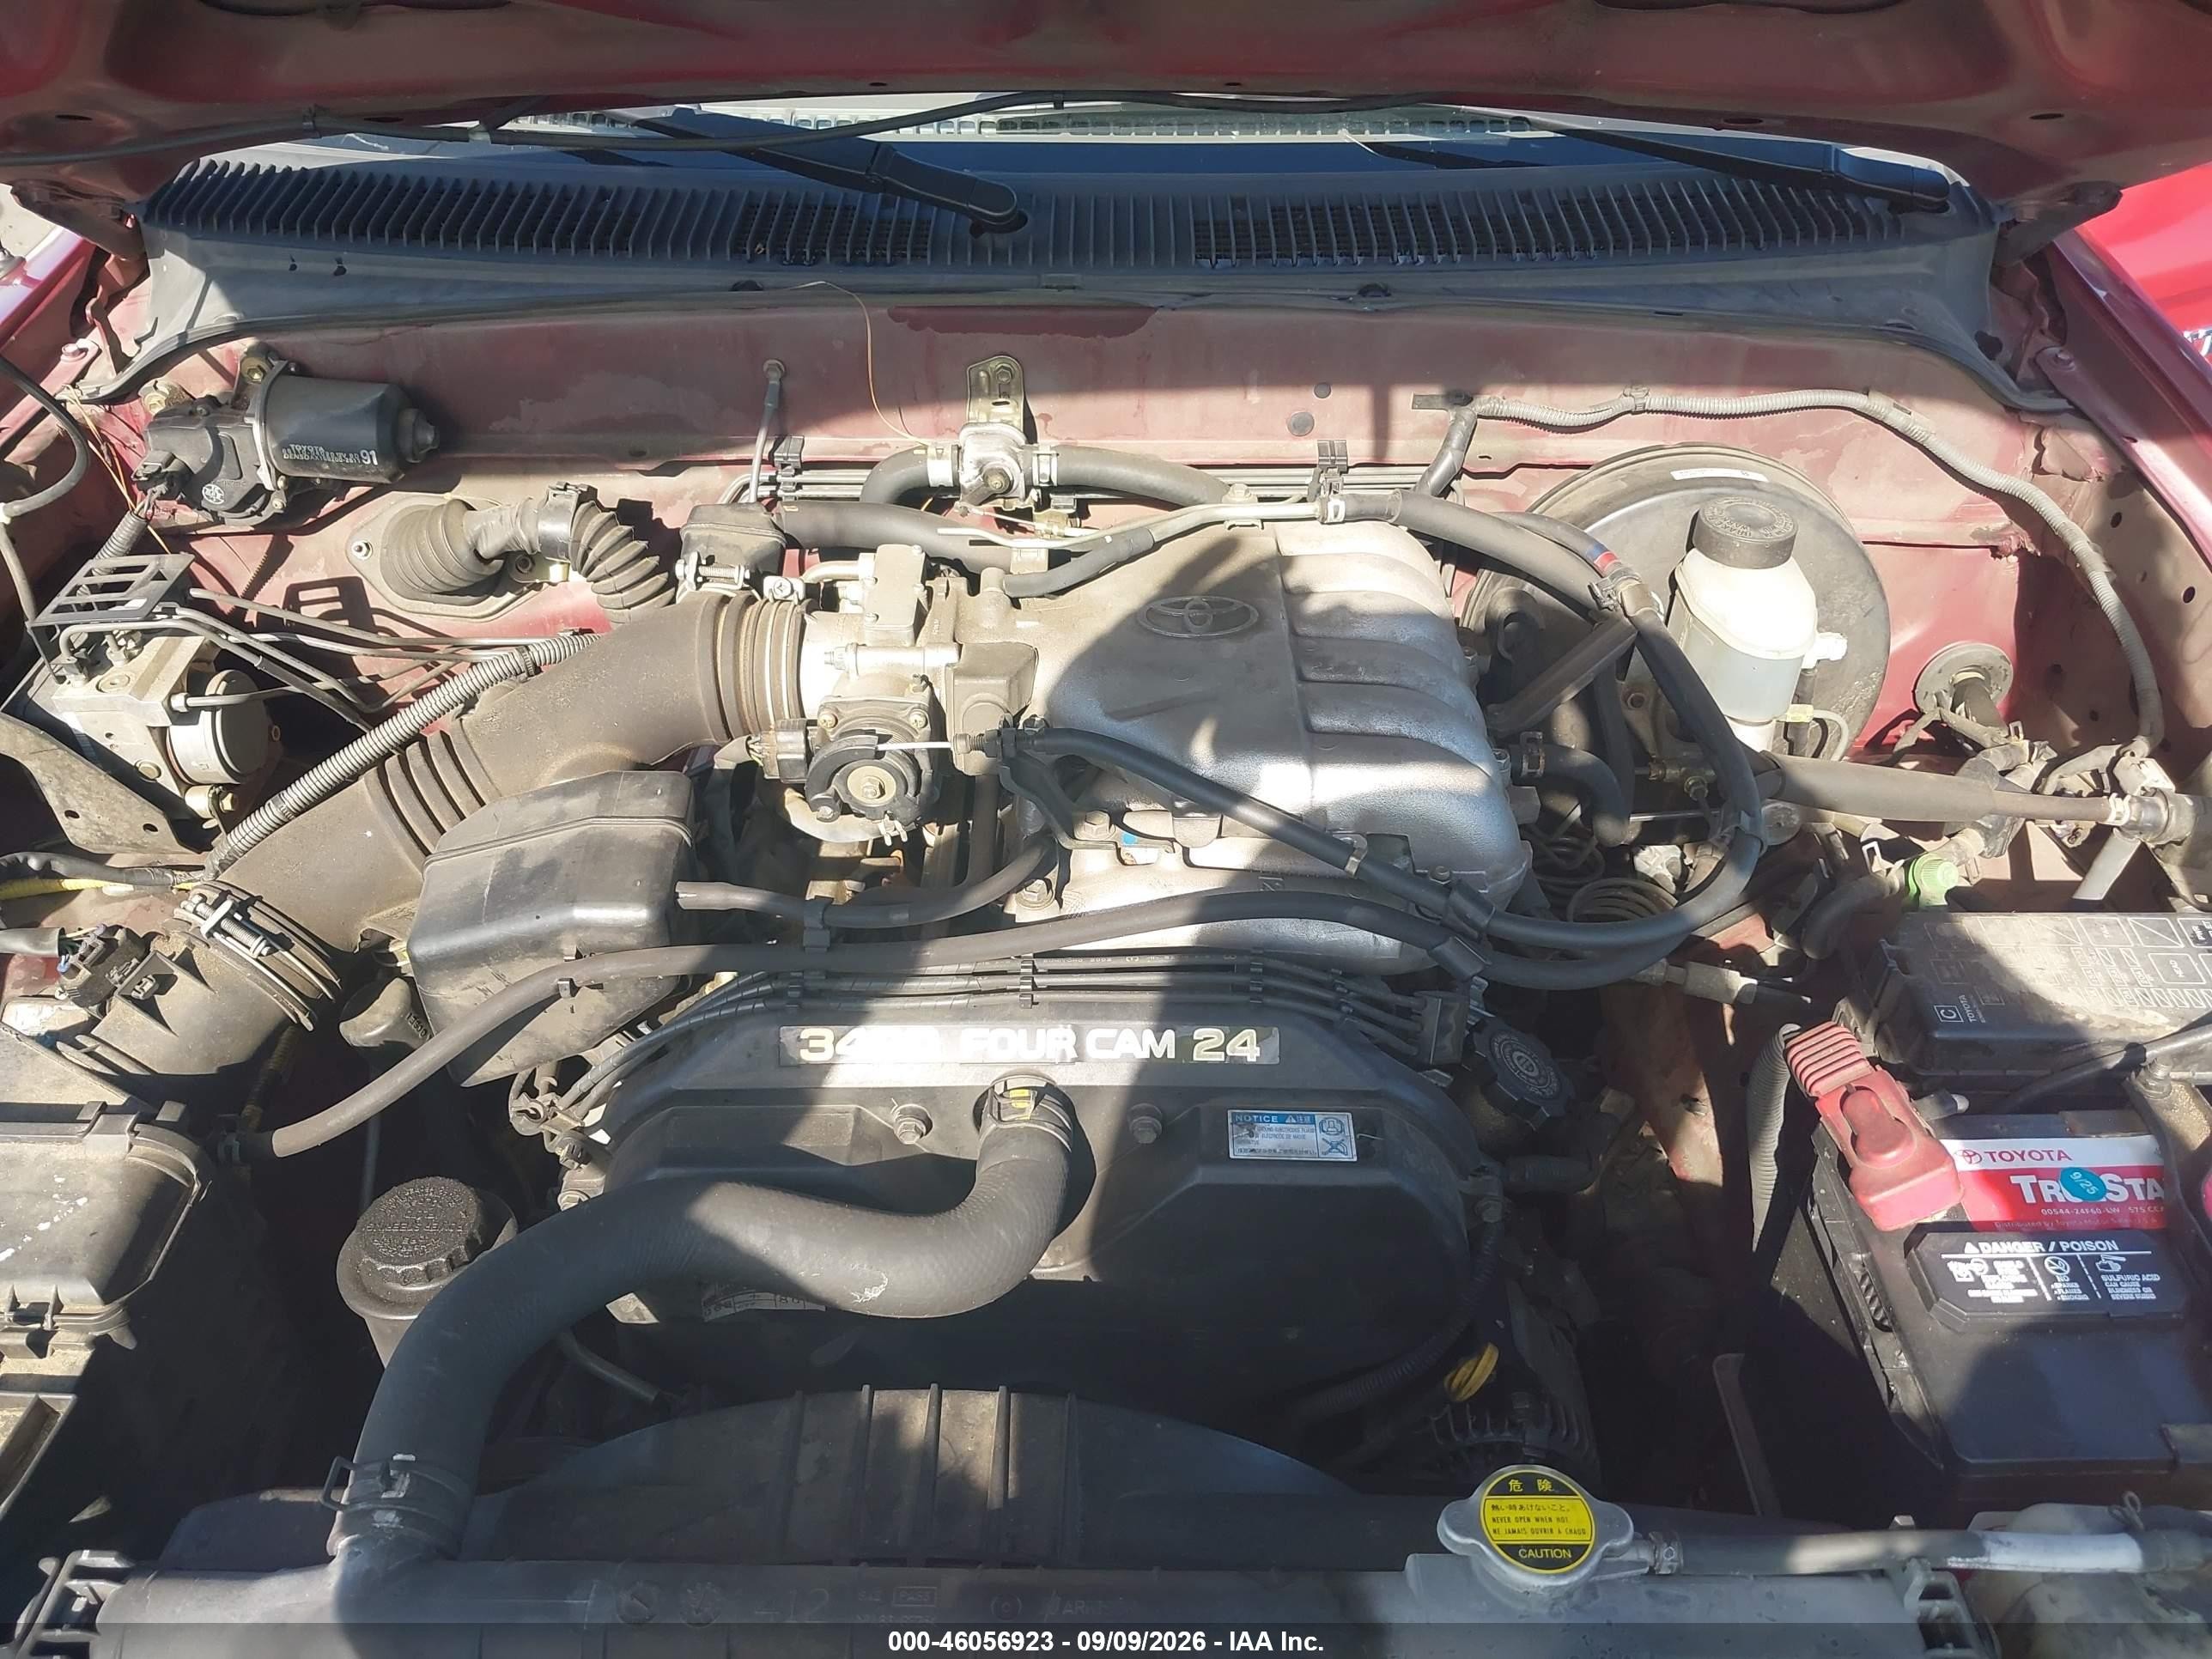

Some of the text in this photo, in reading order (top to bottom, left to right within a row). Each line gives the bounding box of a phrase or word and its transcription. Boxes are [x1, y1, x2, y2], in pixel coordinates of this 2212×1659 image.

[289, 443, 325, 454] TOYOTA
[360, 449, 379, 465] 91
[2191, 926, 2206, 940] PWR
[2169, 959, 2185, 978] HEAD
[1940, 1009, 1957, 1019] C
[1959, 994, 1977, 1024] TOYOTA
[799, 1027, 1261, 1062] 34 FOUR CAM 24
[1235, 1115, 1279, 1123] NOTICE
[1984, 1149, 2073, 1163] TOYOTA
[2010, 1173, 2165, 1204] TRSTA
[2069, 1171, 2098, 1195] 9/25
[1978, 1240, 2119, 1254] DANGER / POISON
[1508, 1479, 1553, 1492] 危険
[1518, 1548, 1572, 1559] CAUTION
